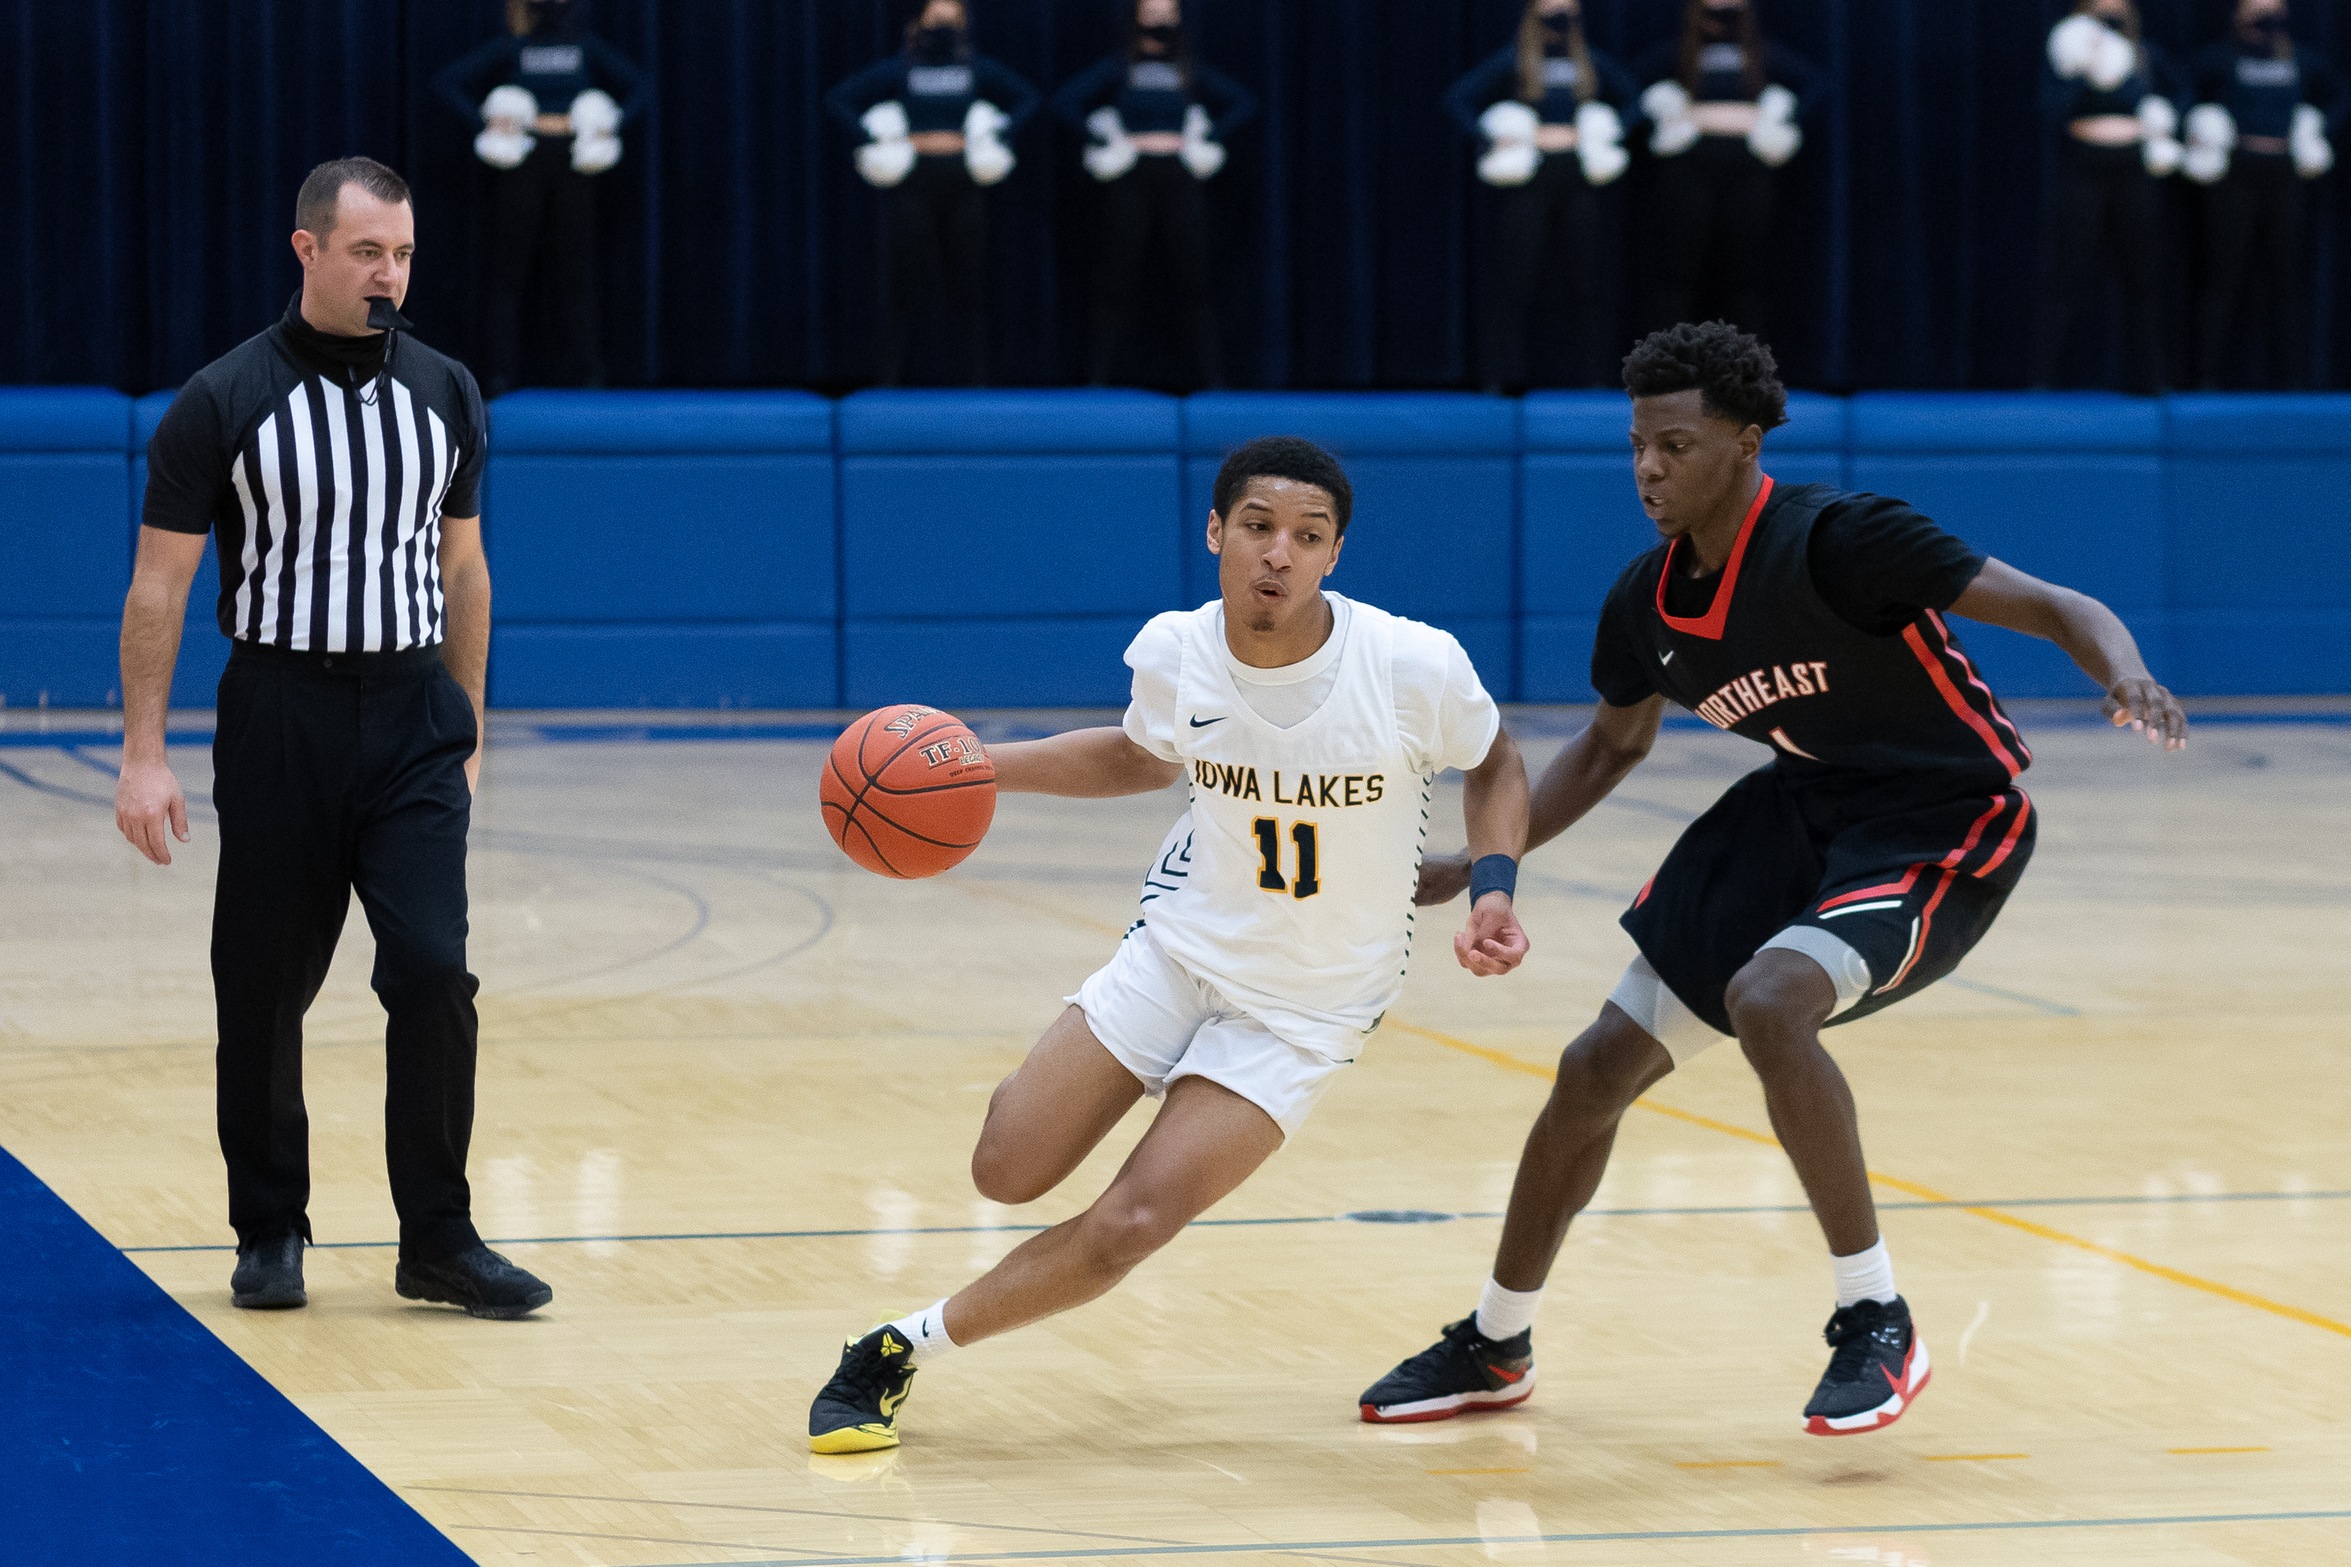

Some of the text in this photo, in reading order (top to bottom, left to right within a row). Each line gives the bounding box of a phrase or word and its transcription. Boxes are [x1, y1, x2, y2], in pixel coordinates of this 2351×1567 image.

[1194, 759, 1385, 808] IOWA LAKES
[1251, 815, 1321, 901] 11
